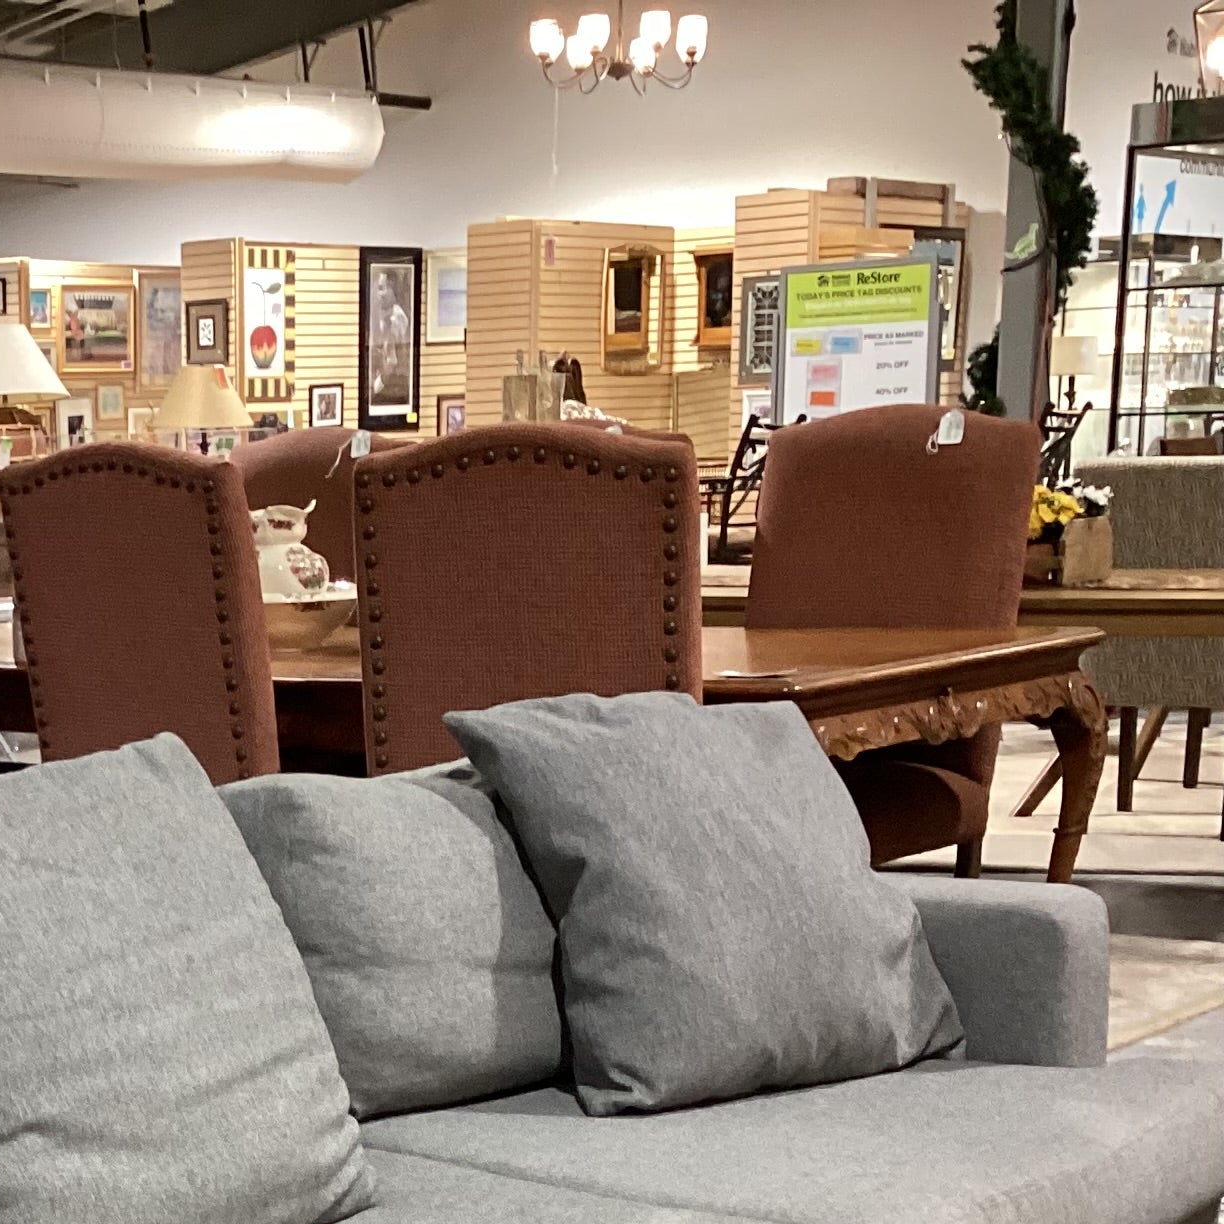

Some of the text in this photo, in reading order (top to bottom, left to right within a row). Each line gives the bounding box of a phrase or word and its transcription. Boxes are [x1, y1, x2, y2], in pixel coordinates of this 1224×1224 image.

[857, 272, 900, 285] ReStore
[796, 285, 922, 301] TODAY'S PRICE TAG DISCOUNTS
[895, 331, 924, 339] MARKED
[876, 360, 909, 370] 20% OFF
[875, 387, 908, 396] 40% OFF
